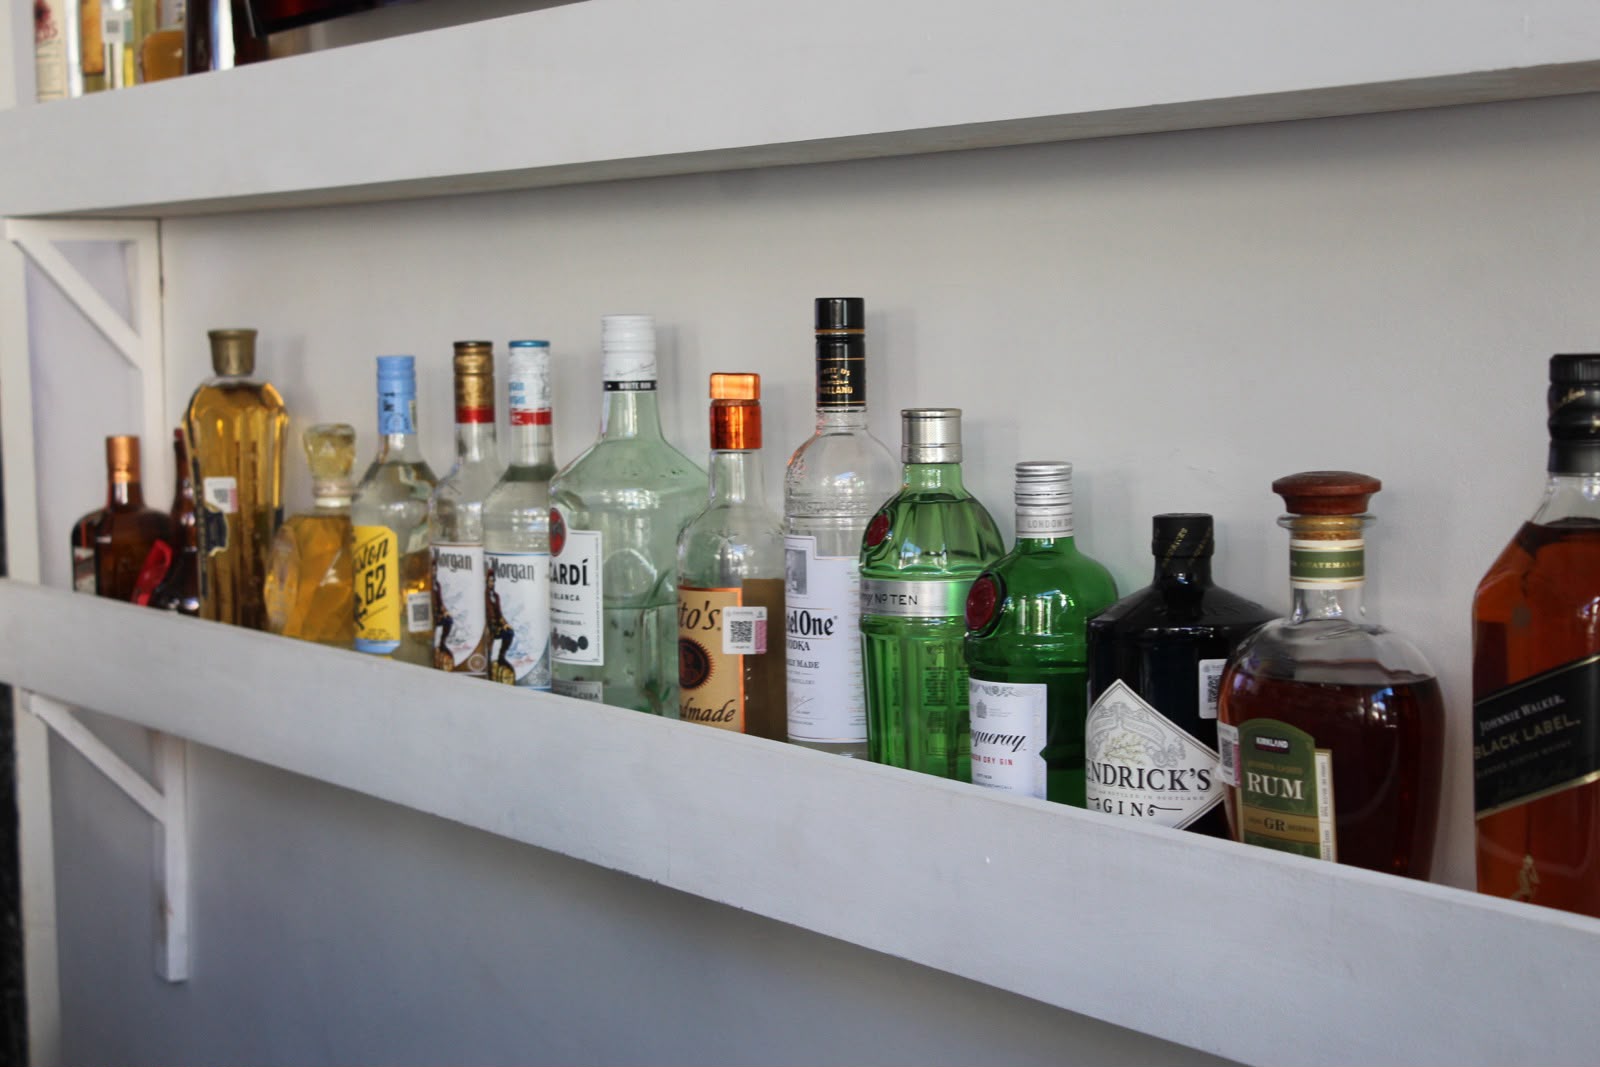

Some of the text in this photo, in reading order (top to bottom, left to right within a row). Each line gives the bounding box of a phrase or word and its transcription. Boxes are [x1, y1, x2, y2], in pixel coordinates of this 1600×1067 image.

[489, 555, 535, 583] Morgan
[548, 557, 588, 587] ARDÍ
[365, 563, 386, 605] 62
[889, 594, 918, 605] TEN
[678, 597, 718, 632] to's
[799, 609, 834, 636] One
[786, 639, 811, 651] ODKA
[679, 696, 736, 722] dmade
[1474, 732, 1520, 759] BLACK
[983, 755, 996, 765] DRY
[999, 758, 1013, 766] GIN
[1246, 771, 1304, 800] RUM
[1103, 798, 1143, 817] GIN
[1263, 816, 1286, 832] GR
